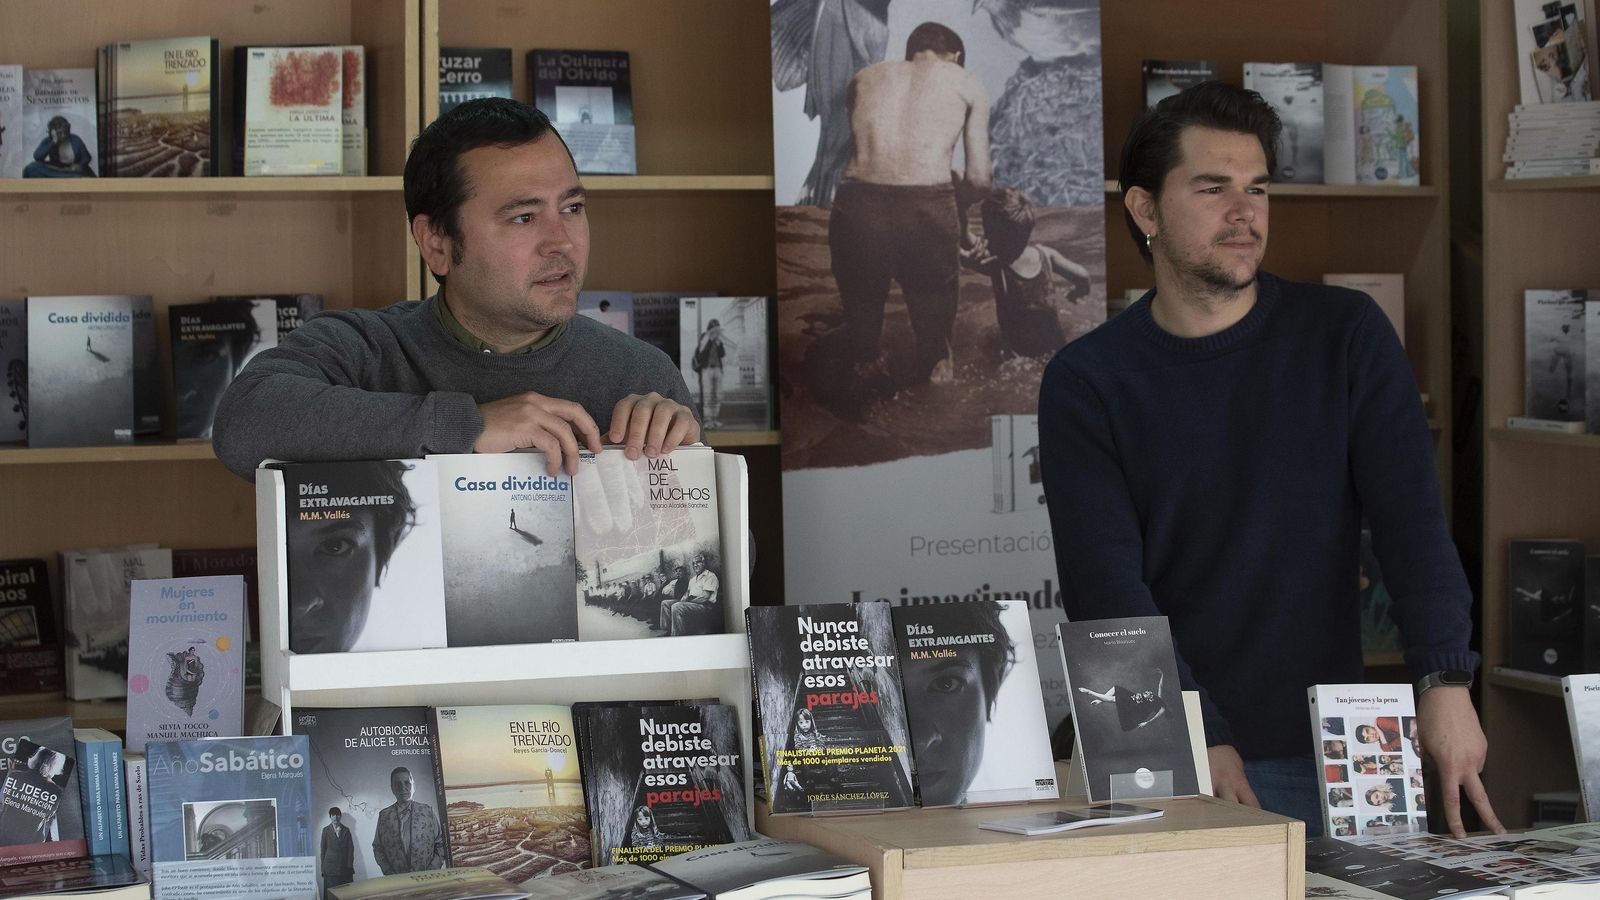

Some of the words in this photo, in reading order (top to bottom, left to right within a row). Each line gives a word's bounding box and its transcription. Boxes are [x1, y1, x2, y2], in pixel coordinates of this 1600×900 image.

[164, 58, 206, 69] TRENZADO
[539, 68, 563, 81] del
[48, 312, 78, 324] Casa
[81, 311, 130, 324] dividida
[277, 317, 304, 329] iste
[647, 458, 679, 472] MAL
[454, 476, 497, 491] Casa
[501, 475, 569, 491] dividida
[648, 473, 670, 486] DE
[299, 482, 329, 496] DÍAS
[649, 487, 711, 501] MUCHOS
[299, 495, 395, 509] EXTRAVAGANTES
[300, 511, 323, 521] M.M.
[323, 510, 351, 520] Vallés
[910, 528, 1052, 557] Presentació
[160, 586, 215, 601] Mujeres
[179, 601, 195, 610] en
[146, 610, 228, 624] movimiento
[797, 616, 859, 635] Nunca
[906, 623, 934, 636] DÍAS
[1089, 631, 1119, 639] Conocer
[1120, 628, 1127, 636] el
[1128, 627, 1146, 636] suelo
[799, 634, 869, 653] debiste
[908, 634, 996, 649] EXTRAVAGANTES
[910, 650, 931, 660] M.M.
[933, 649, 957, 659] Vallés
[801, 653, 895, 671] atravesar
[803, 674, 846, 689] esos
[806, 689, 879, 711] parajes
[1335, 696, 1348, 704] Tan
[1348, 696, 1371, 705] jóvenes
[158, 723, 181, 731] SILVIA
[510, 721, 526, 734] EN
[527, 721, 541, 733] EL
[542, 719, 561, 733] RÍO
[639, 717, 702, 736] Nunca
[147, 731, 178, 739] MANUEL
[180, 730, 219, 738] MACHUCA
[510, 734, 572, 747] TRENZADO
[344, 738, 358, 748] DE
[360, 737, 387, 747] ALICE
[389, 736, 398, 746] B.
[641, 735, 712, 753] debiste
[776, 748, 811, 757] FINALISTA
[812, 748, 825, 756] DEL
[827, 747, 854, 755] PREMIO
[855, 746, 887, 754] PLANETA
[888, 745, 906, 753] 2021
[642, 752, 740, 771] atravesar
[777, 758, 791, 766] Más
[792, 757, 801, 765] de
[803, 757, 821, 765] 1000
[821, 756, 860, 766] ejemplares
[261, 771, 277, 780] Elena
[278, 770, 304, 779] Marqués
[644, 772, 688, 787] esos
[4, 776, 17, 790] EL
[20, 782, 58, 805] JUEGO
[646, 784, 721, 808] parajes
[807, 794, 830, 803] JORGE
[831, 792, 865, 801] SÁNCHEZ
[3, 787, 11, 796] DE
[11, 790, 19, 798] LA
[20, 794, 53, 811] INTENCIÓN
[4, 796, 20, 809] Elena
[612, 855, 627, 863] Más
[628, 854, 638, 862] de
[640, 854, 658, 862] 1000
